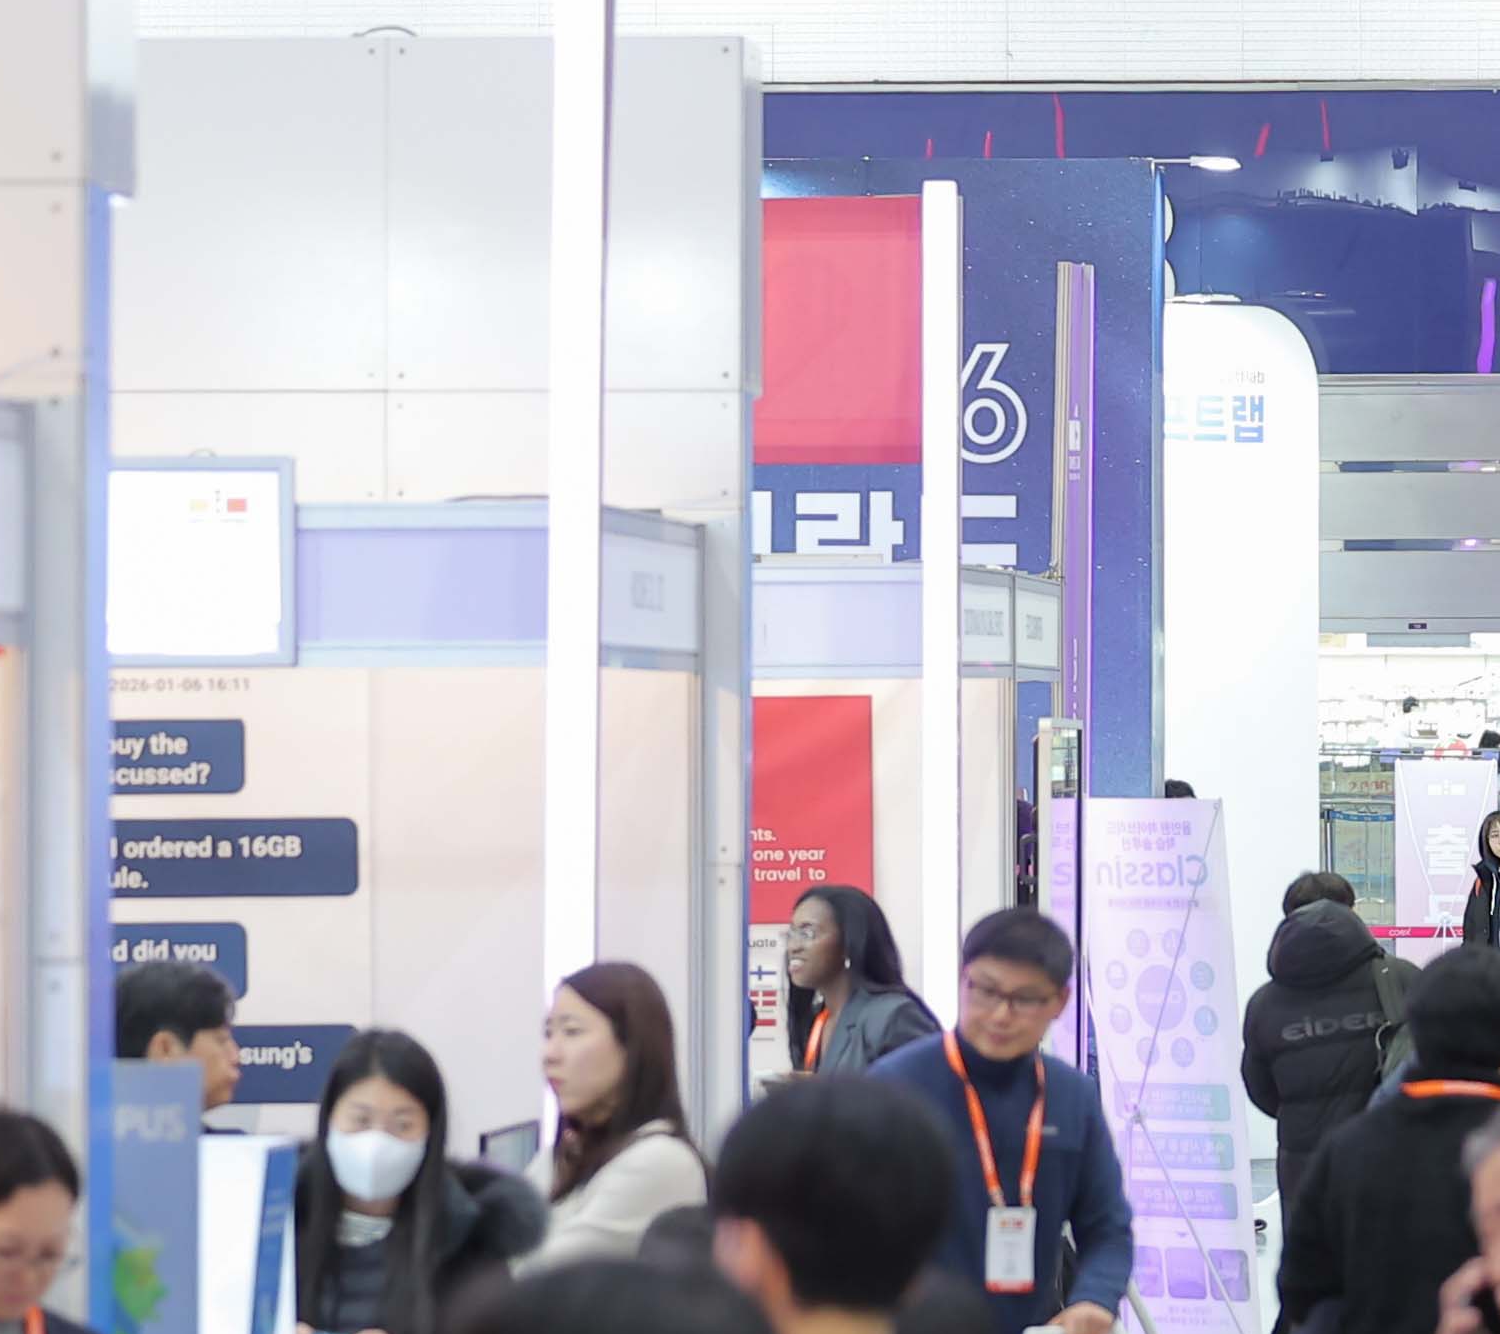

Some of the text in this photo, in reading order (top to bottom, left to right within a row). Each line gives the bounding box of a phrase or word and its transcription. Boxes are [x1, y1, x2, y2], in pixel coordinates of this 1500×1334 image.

[148, 731, 188, 755] the
[122, 835, 213, 859] ordered
[216, 841, 233, 859] a
[238, 835, 302, 859] 16GB
[752, 849, 826, 865] one year
[753, 867, 826, 881] travel to
[132, 939, 169, 963] did
